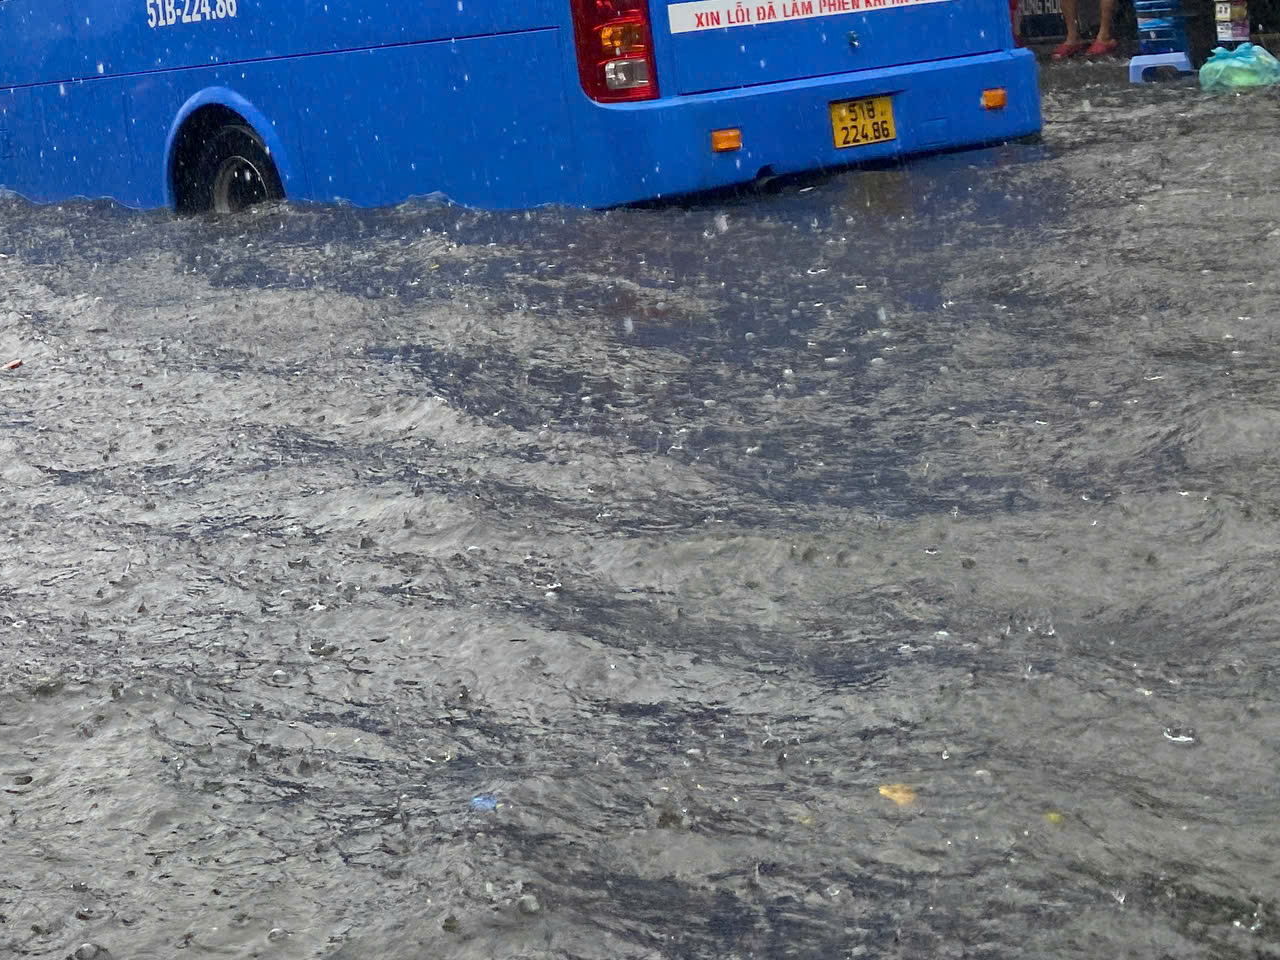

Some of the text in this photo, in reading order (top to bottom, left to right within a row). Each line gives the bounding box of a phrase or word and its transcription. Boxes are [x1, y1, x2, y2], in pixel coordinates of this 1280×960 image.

[695, 9, 721, 28] XIN
[726, 0, 751, 25] LỖI
[756, 0, 778, 22] ĐÃ
[840, 120, 890, 145] 224.86
